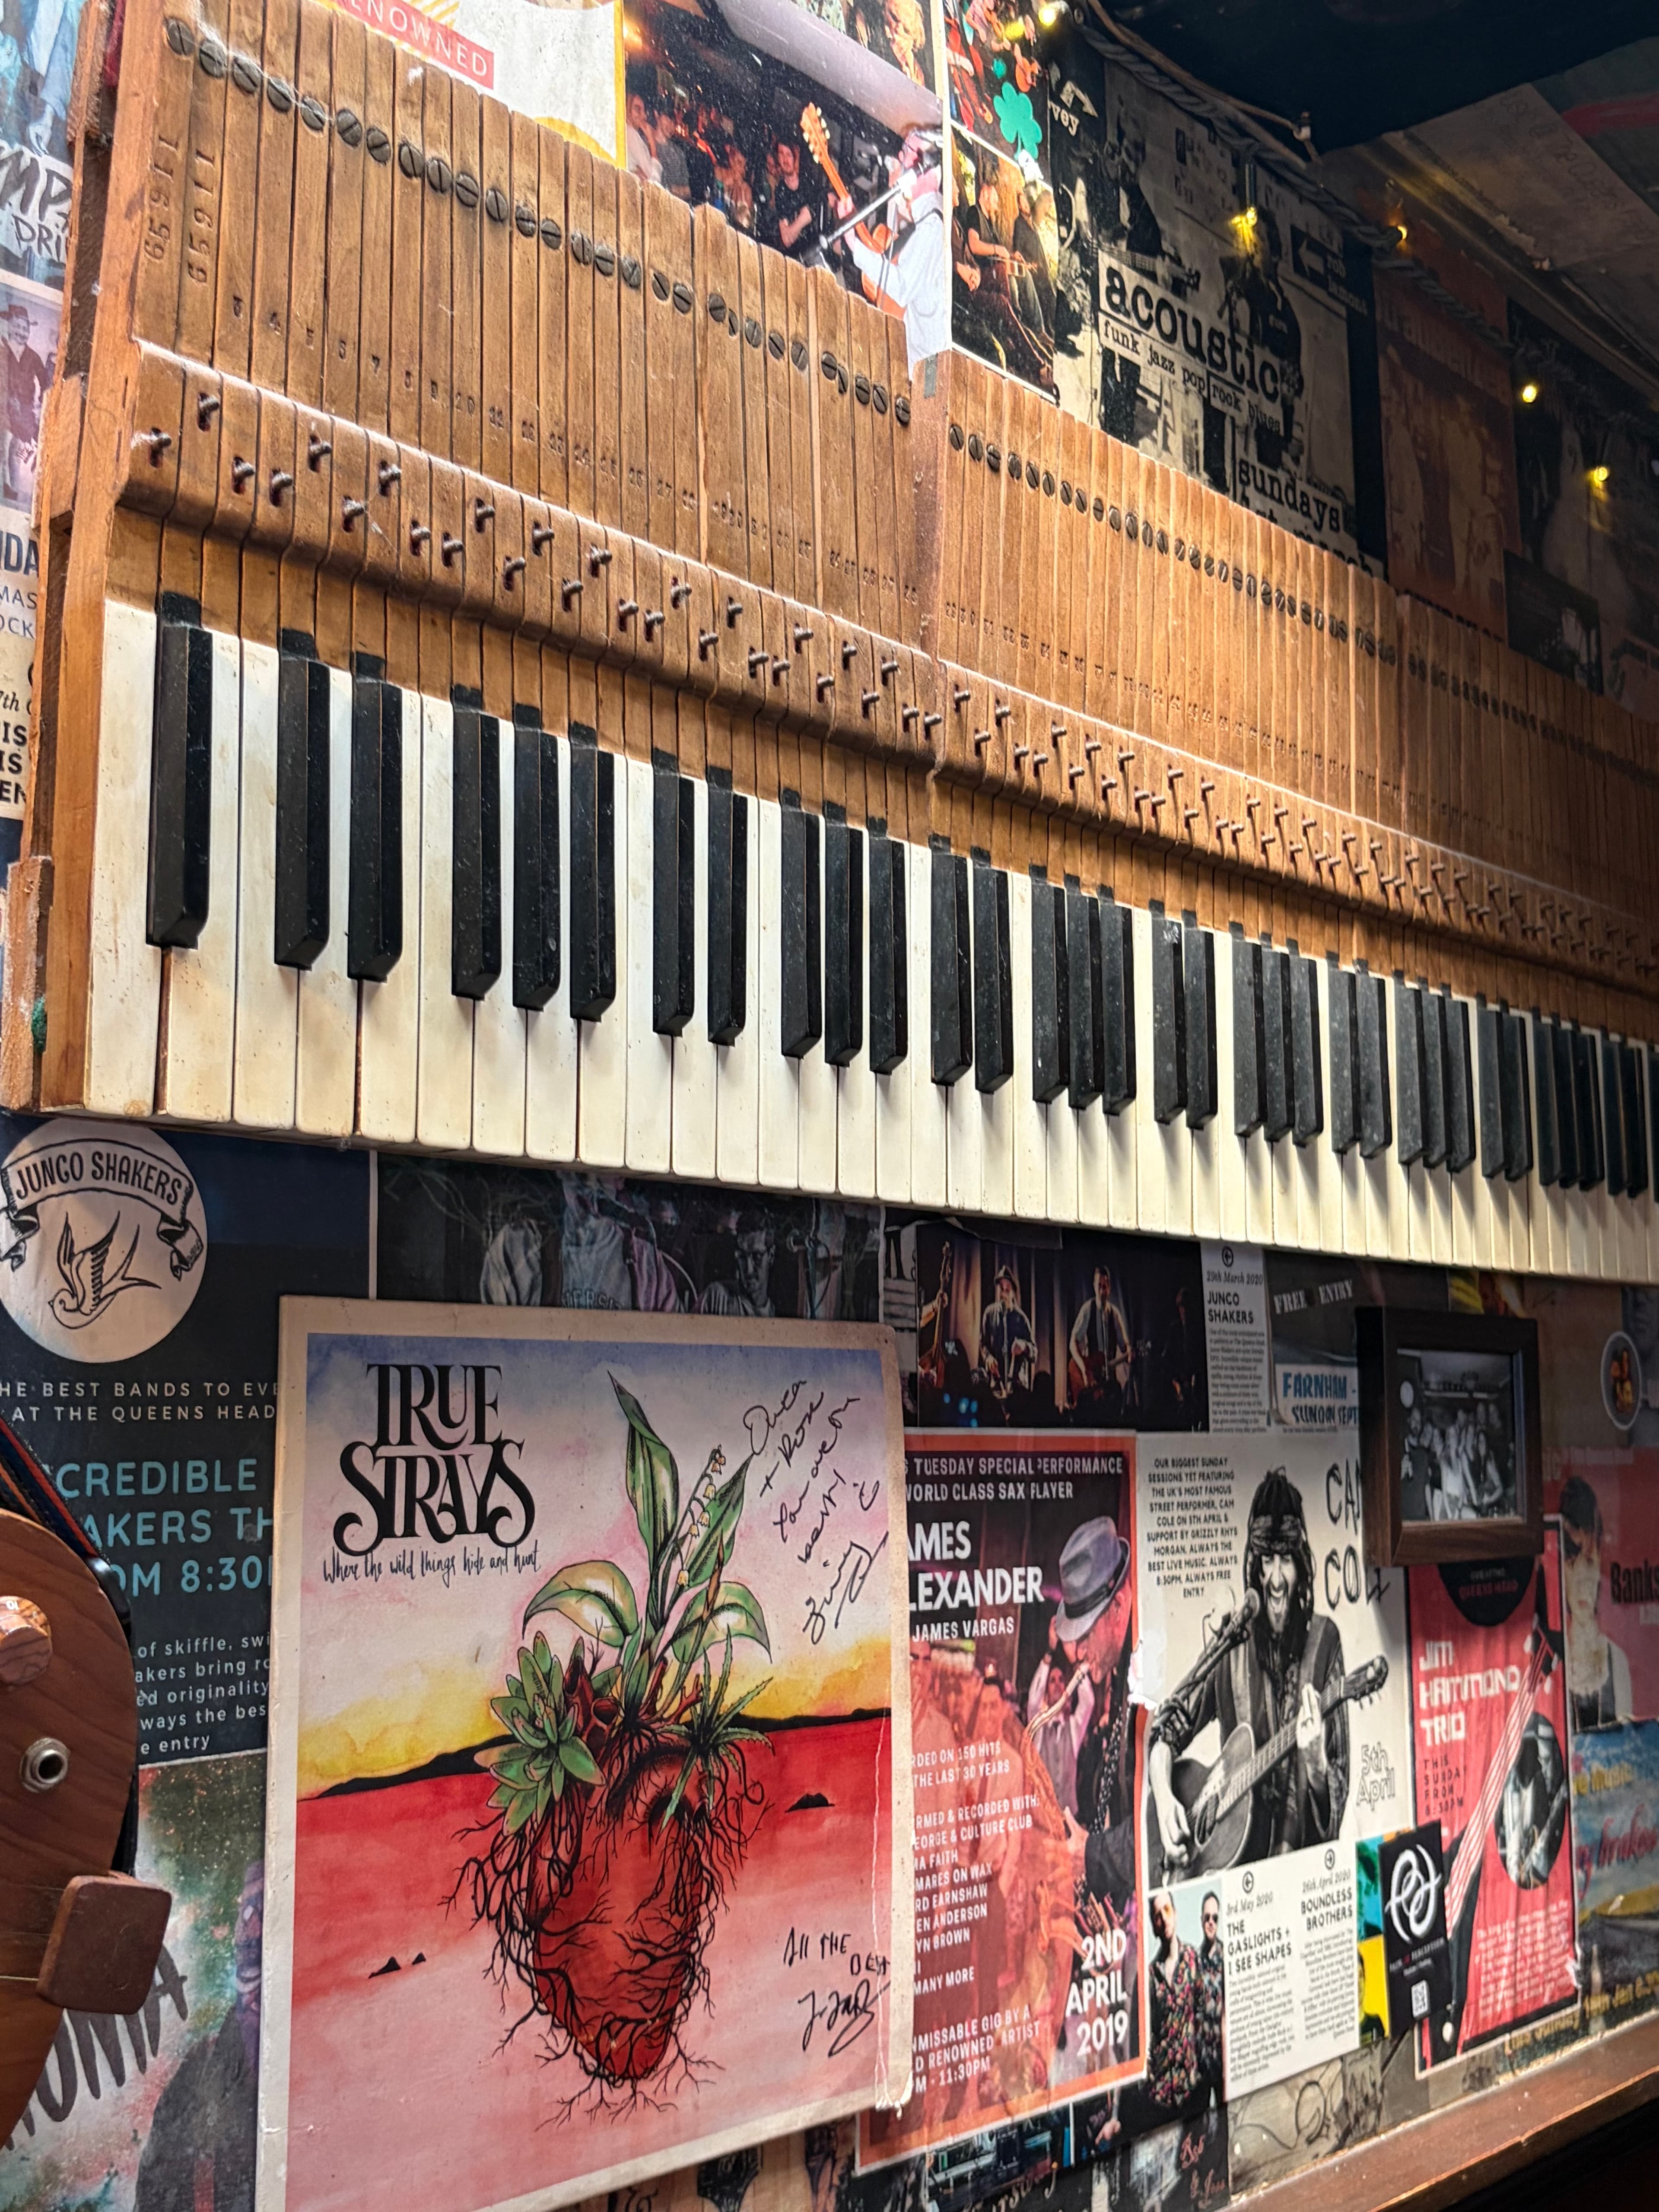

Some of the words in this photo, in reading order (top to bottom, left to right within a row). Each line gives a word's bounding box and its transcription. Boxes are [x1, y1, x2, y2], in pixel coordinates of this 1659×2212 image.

[1105, 266, 1279, 404] acoustic
[1103, 321, 1140, 356] funk
[1147, 346, 1175, 375] jazz
[1182, 366, 1205, 395] pop
[1212, 385, 1242, 414] rock
[1239, 458, 1340, 534] sundays
[0, 529, 39, 578] DA
[16, 1152, 84, 1200] JUNCO
[91, 1151, 182, 1206] SHAKERS
[1223, 1271, 1245, 1284] March
[1246, 1272, 1263, 1286] 2020
[1207, 1291, 1239, 1306] JUNCO
[1274, 1289, 1307, 1314] FREE
[1319, 1279, 1353, 1305] ENTRY
[1208, 1309, 1254, 1325] SHAKERS
[43, 1382, 100, 1396] BEST
[114, 1382, 190, 1396] BANDS
[204, 1382, 230, 1396] TO
[1283, 1372, 1348, 1400] FARNHAM
[12, 1407, 39, 1422] AT
[54, 1406, 98, 1421] THE
[112, 1405, 204, 1423] QUEENS
[217, 1405, 275, 1420] HEAD
[366, 1363, 502, 1451] TRUE
[913, 1457, 975, 1476] TUESDAY
[979, 1457, 1035, 1475] SPECIAL
[1037, 1456, 1123, 1475] PERFORMANCE
[1154, 1458, 1169, 1469] OUR
[1171, 1457, 1199, 1468] BIGGEST
[1201, 1456, 1228, 1467] SUNDAY
[57, 1459, 257, 1499] CREDIBLE
[952, 1483, 995, 1501] CLASS
[998, 1482, 1026, 1500] SAX
[1030, 1481, 1074, 1499] PLAYER
[1148, 1472, 1183, 1484] SESSIONS
[1185, 1472, 1197, 1483] YET
[1198, 1470, 1235, 1482] FEATURING
[1152, 1487, 1165, 1498] THE
[1184, 1486, 1203, 1497] MOST
[1205, 1484, 1232, 1496] FAMOUS
[333, 1438, 535, 1556] STRAYS
[1150, 1501, 1175, 1513] STREET
[1219, 1498, 1235, 1509] CAM
[83, 1510, 211, 1548] AKERS
[1157, 1516, 1175, 1528] COLE
[1176, 1515, 1187, 1526] ON
[1203, 1513, 1222, 1525] APRIL
[1147, 1530, 1178, 1543] SUPPORT
[1180, 1529, 1189, 1541] BY
[1190, 1527, 1219, 1540] GRIZZLY
[1189, 1542, 1219, 1554] ALWAYS
[1221, 1541, 1232, 1551] THE
[181, 1555, 272, 1592] 8:30
[324, 1546, 361, 1584] Where
[390, 1549, 416, 1580] wild
[421, 1549, 455, 1588] things
[490, 1546, 509, 1576] and
[1148, 1560, 1165, 1573] BEST
[1166, 1559, 1183, 1570] LIVE
[1209, 1555, 1238, 1567] ALWAYS
[1185, 1571, 1215, 1584] ALWAYS
[1216, 1570, 1231, 1581] FREE
[1183, 1586, 1205, 1599] ENTRY
[912, 1620, 958, 1643] JAMES
[962, 1616, 1014, 1637] VARGAS
[138, 1641, 156, 1658] of
[165, 1637, 232, 1656] skiffle,
[1419, 1641, 1454, 1671] JIM
[135, 1666, 186, 1683] akers
[196, 1659, 246, 1677] bring
[167, 1680, 269, 1704] originality
[1419, 1665, 1521, 1710] HAMMOND
[141, 1713, 187, 1731] ways
[196, 1708, 226, 1724] the
[1420, 1711, 1466, 1747] TRIO
[159, 1735, 210, 1751] entry
[940, 1748, 954, 1762] ON
[958, 1744, 976, 1761] 150
[979, 1740, 1001, 1757] HITS
[913, 1772, 933, 1788] THE
[936, 1767, 960, 1785] LAST
[963, 1765, 976, 1780] 30
[979, 1759, 1010, 1777] YEARS
[1424, 1754, 1448, 1770] THIS
[1425, 1784, 1454, 1800] FROM
[913, 1811, 945, 1829] RMED
[958, 1798, 1010, 1821] RECORDED
[960, 1819, 1005, 1841] CULTURE
[1007, 1814, 1033, 1832] CLUB
[929, 1849, 959, 1868] FAITH
[915, 1871, 950, 1891] MARES
[953, 1867, 968, 1884] ON
[970, 1862, 993, 1880] WAX
[915, 1896, 930, 1913] RD
[932, 1882, 988, 1909] EARNSHAW
[1301, 1886, 1352, 1915] BOUNDLESS
[916, 1917, 931, 1933] EN
[933, 1902, 988, 1931] ANDERSON
[1227, 1919, 1245, 1937] THE
[1306, 1904, 1353, 1931] BROTHERS
[820, 1931, 851, 1960] THE
[933, 1927, 970, 1950] BROWN
[1081, 1928, 1127, 1970] 2ND
[1228, 1927, 1281, 1956] GASLIGHTS
[1236, 1955, 1252, 1973] SEE
[1255, 1941, 1291, 1966] SHAPES
[914, 1974, 943, 1996] MANY
[945, 1966, 975, 1987] MORE
[1065, 1970, 1128, 2017] APRIL
[982, 2012, 1002, 2033] GIG
[1005, 2006, 1020, 2025] BY
[1023, 2003, 1031, 2021] A
[928, 2034, 994, 2070] RENOWNED
[1001, 2020, 1041, 2046] ARTIST
[1076, 2009, 1129, 2057] 2019
[939, 2055, 991, 2087] 11:30PM
